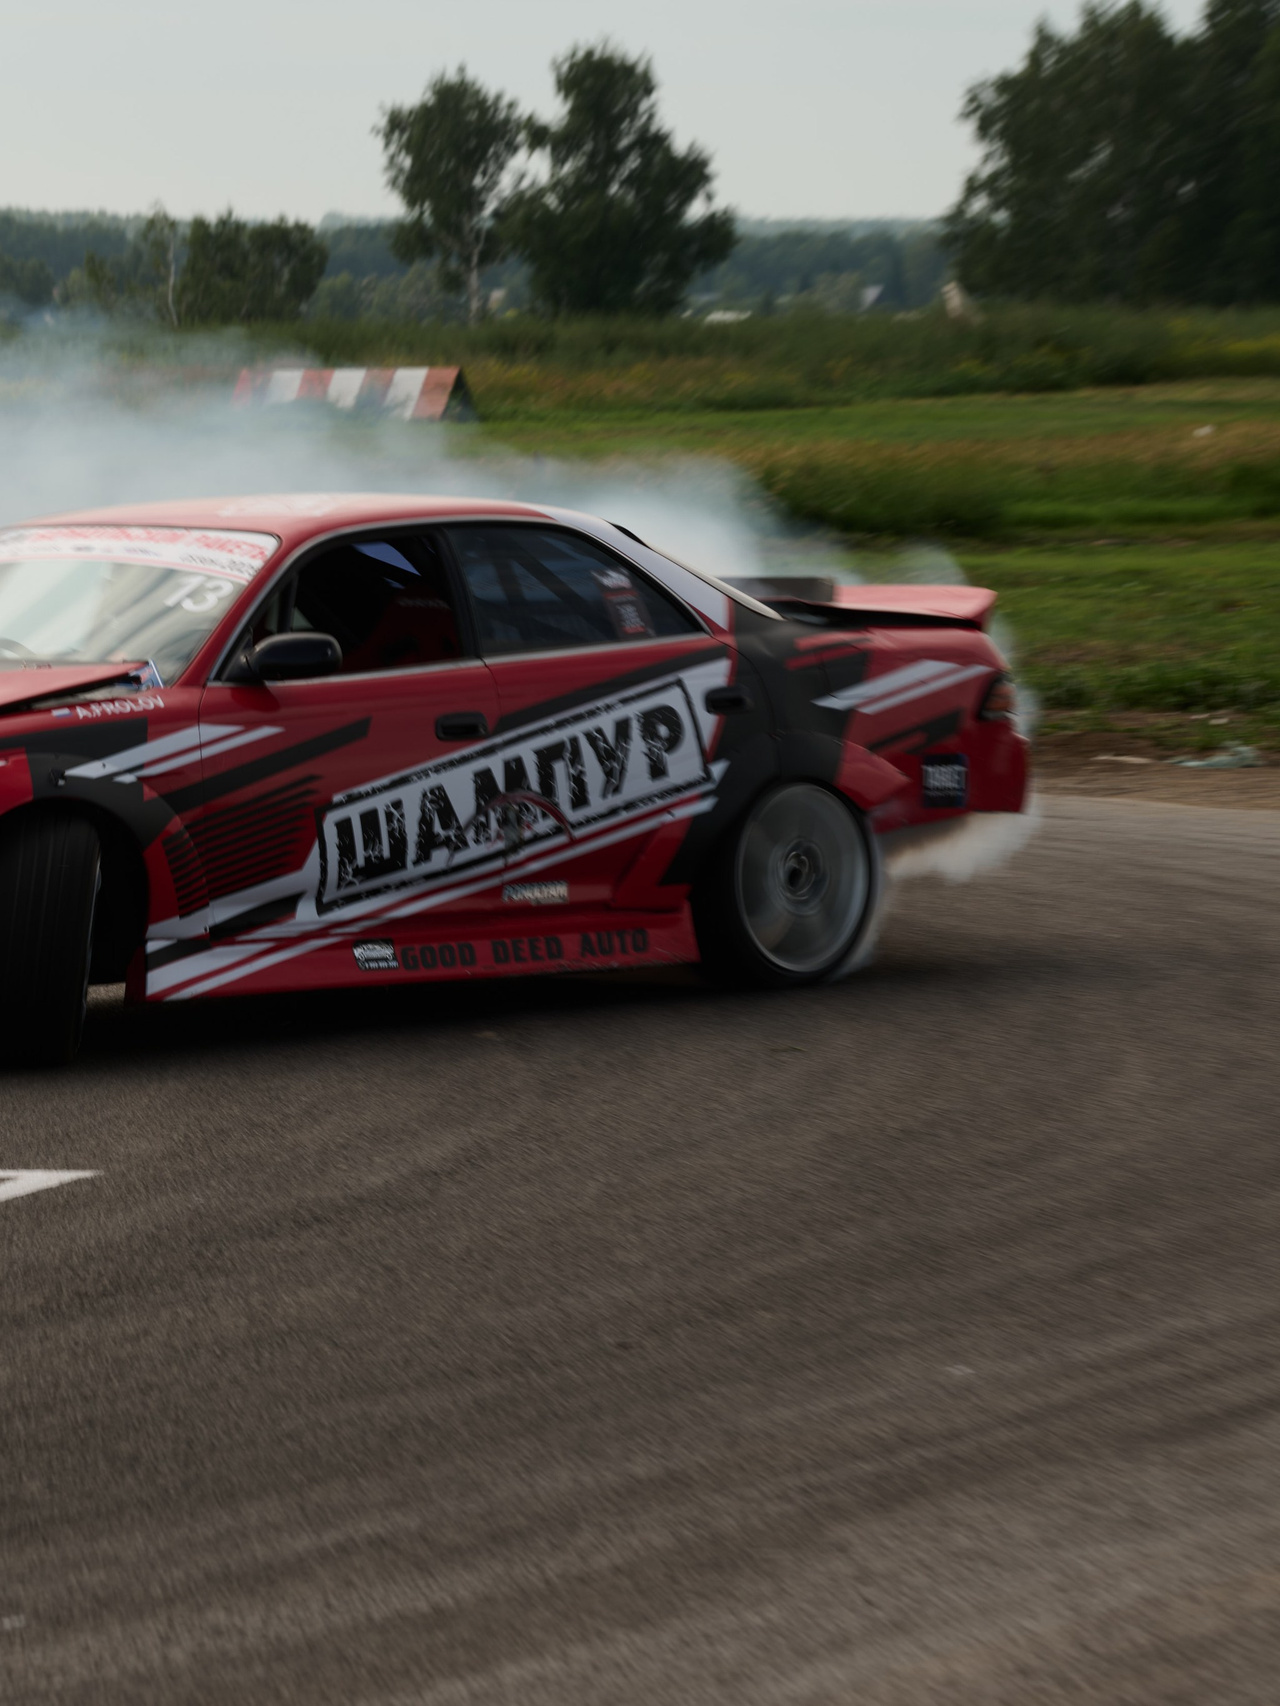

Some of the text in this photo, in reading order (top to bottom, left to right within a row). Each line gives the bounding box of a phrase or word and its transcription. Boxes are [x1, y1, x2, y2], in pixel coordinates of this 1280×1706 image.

[164, 575, 234, 612] 13
[333, 703, 685, 891] ШАМПУР
[400, 927, 650, 970] GOOD DEED AUTO
